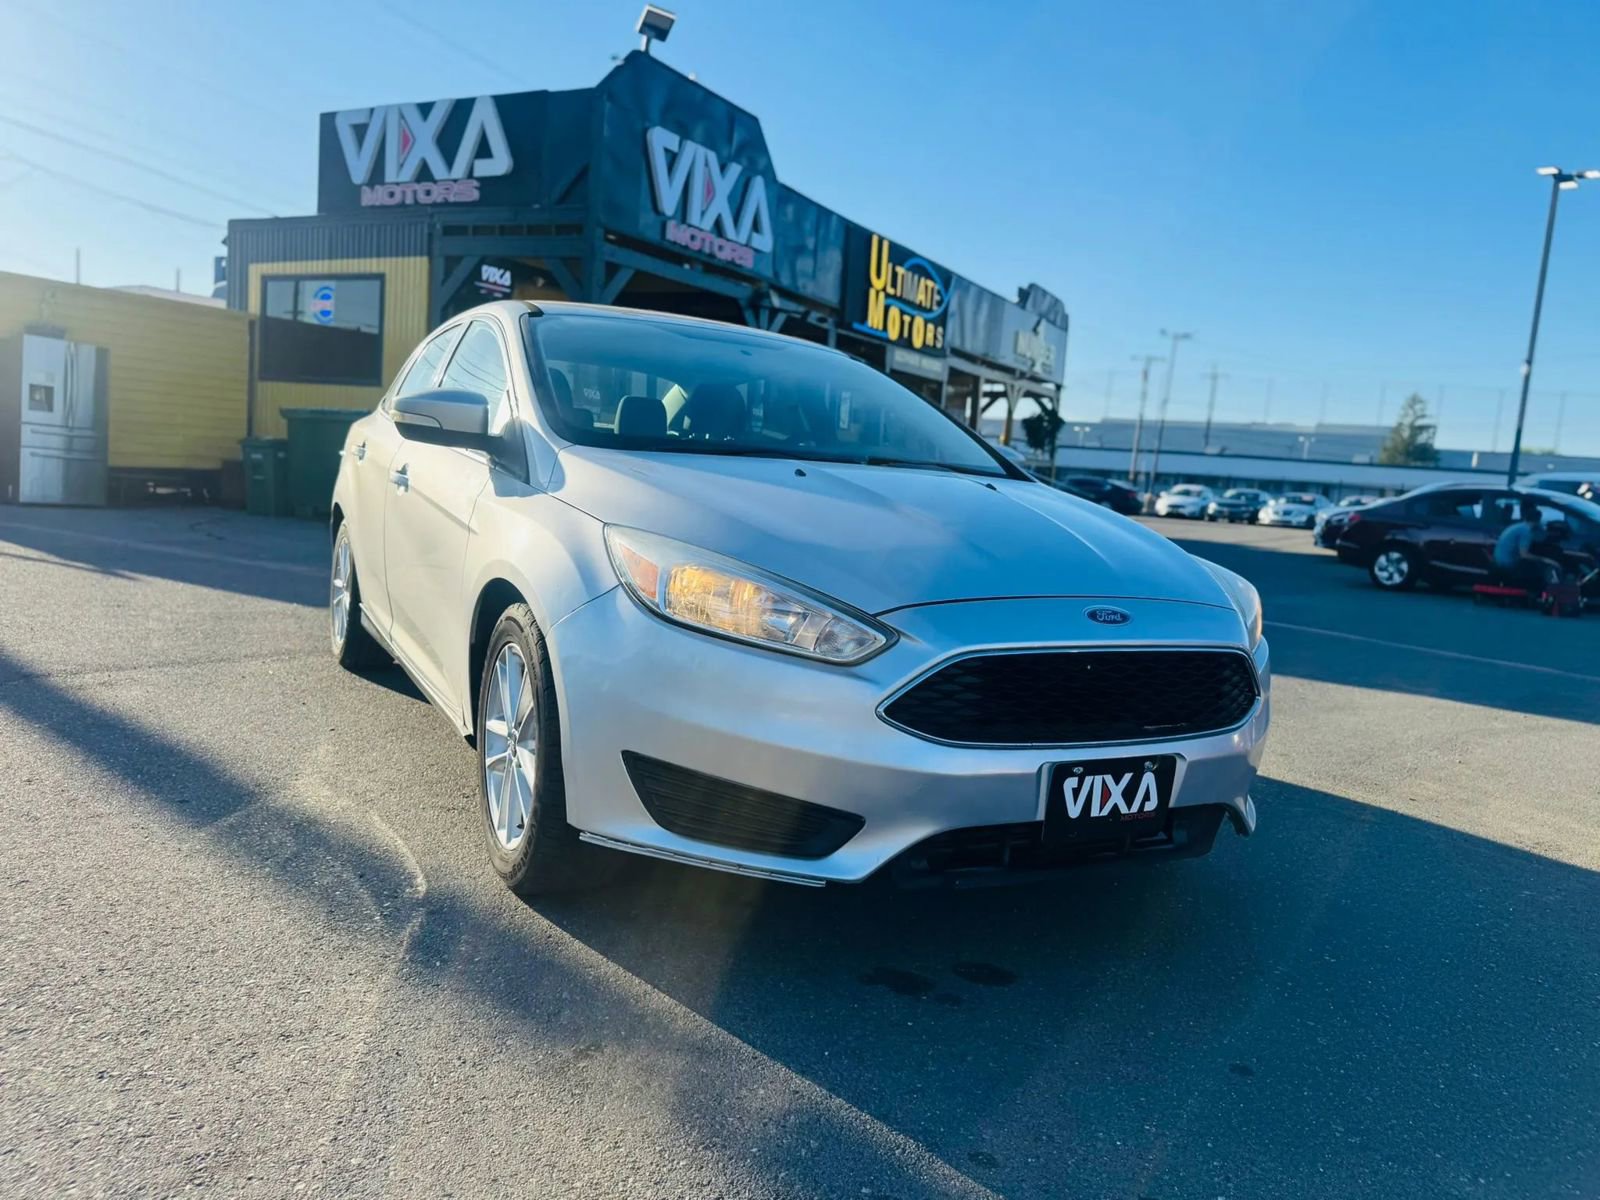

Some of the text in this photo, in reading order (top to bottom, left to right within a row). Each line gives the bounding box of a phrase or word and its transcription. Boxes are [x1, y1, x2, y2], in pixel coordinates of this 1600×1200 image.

[335, 95, 513, 185] VIXA
[360, 179, 481, 206] MOTORS
[646, 125, 774, 254] VIXA
[665, 219, 755, 269] MOTORS
[869, 232, 942, 311] ULTIMATE
[867, 287, 944, 350] MOTORS
[1096, 609, 1123, 621] Ford
[1063, 771, 1158, 819] VIXA
